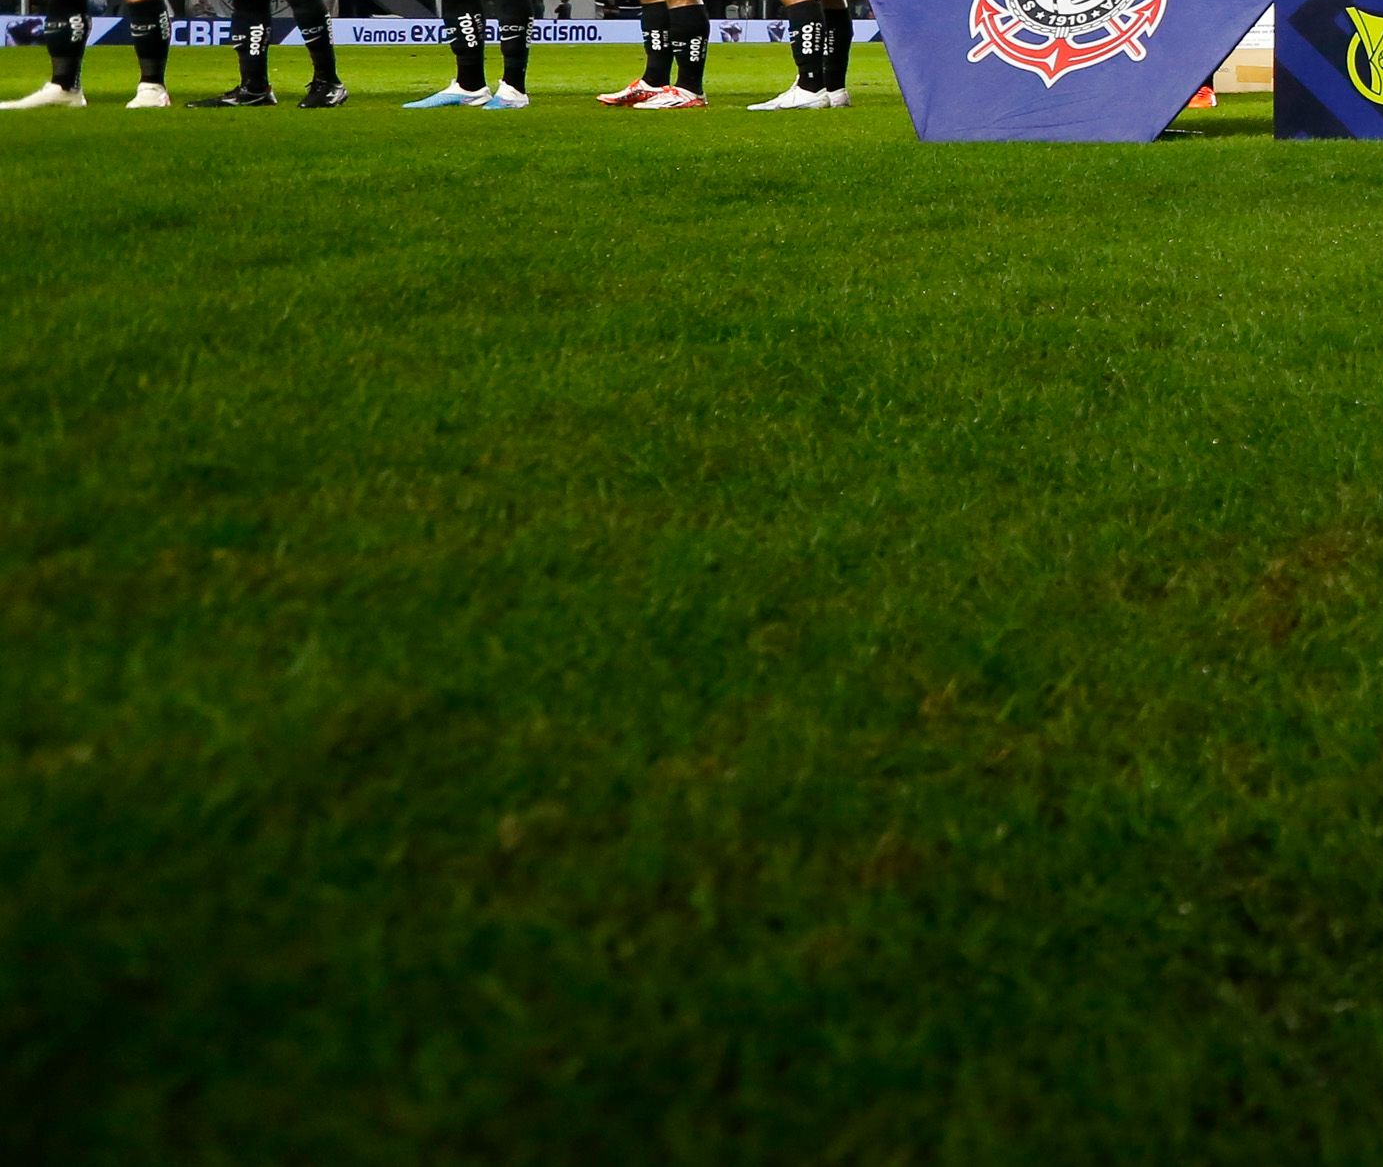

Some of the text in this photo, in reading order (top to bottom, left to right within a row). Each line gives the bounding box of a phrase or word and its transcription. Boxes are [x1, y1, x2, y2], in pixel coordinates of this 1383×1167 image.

[353, 26, 406, 42] Vamos
[531, 20, 602, 41] acismo.
[458, 13, 478, 48] TODOS
[1048, 13, 1087, 26] 1910
[170, 21, 232, 45] CBF
[250, 23, 265, 56] TODOS
